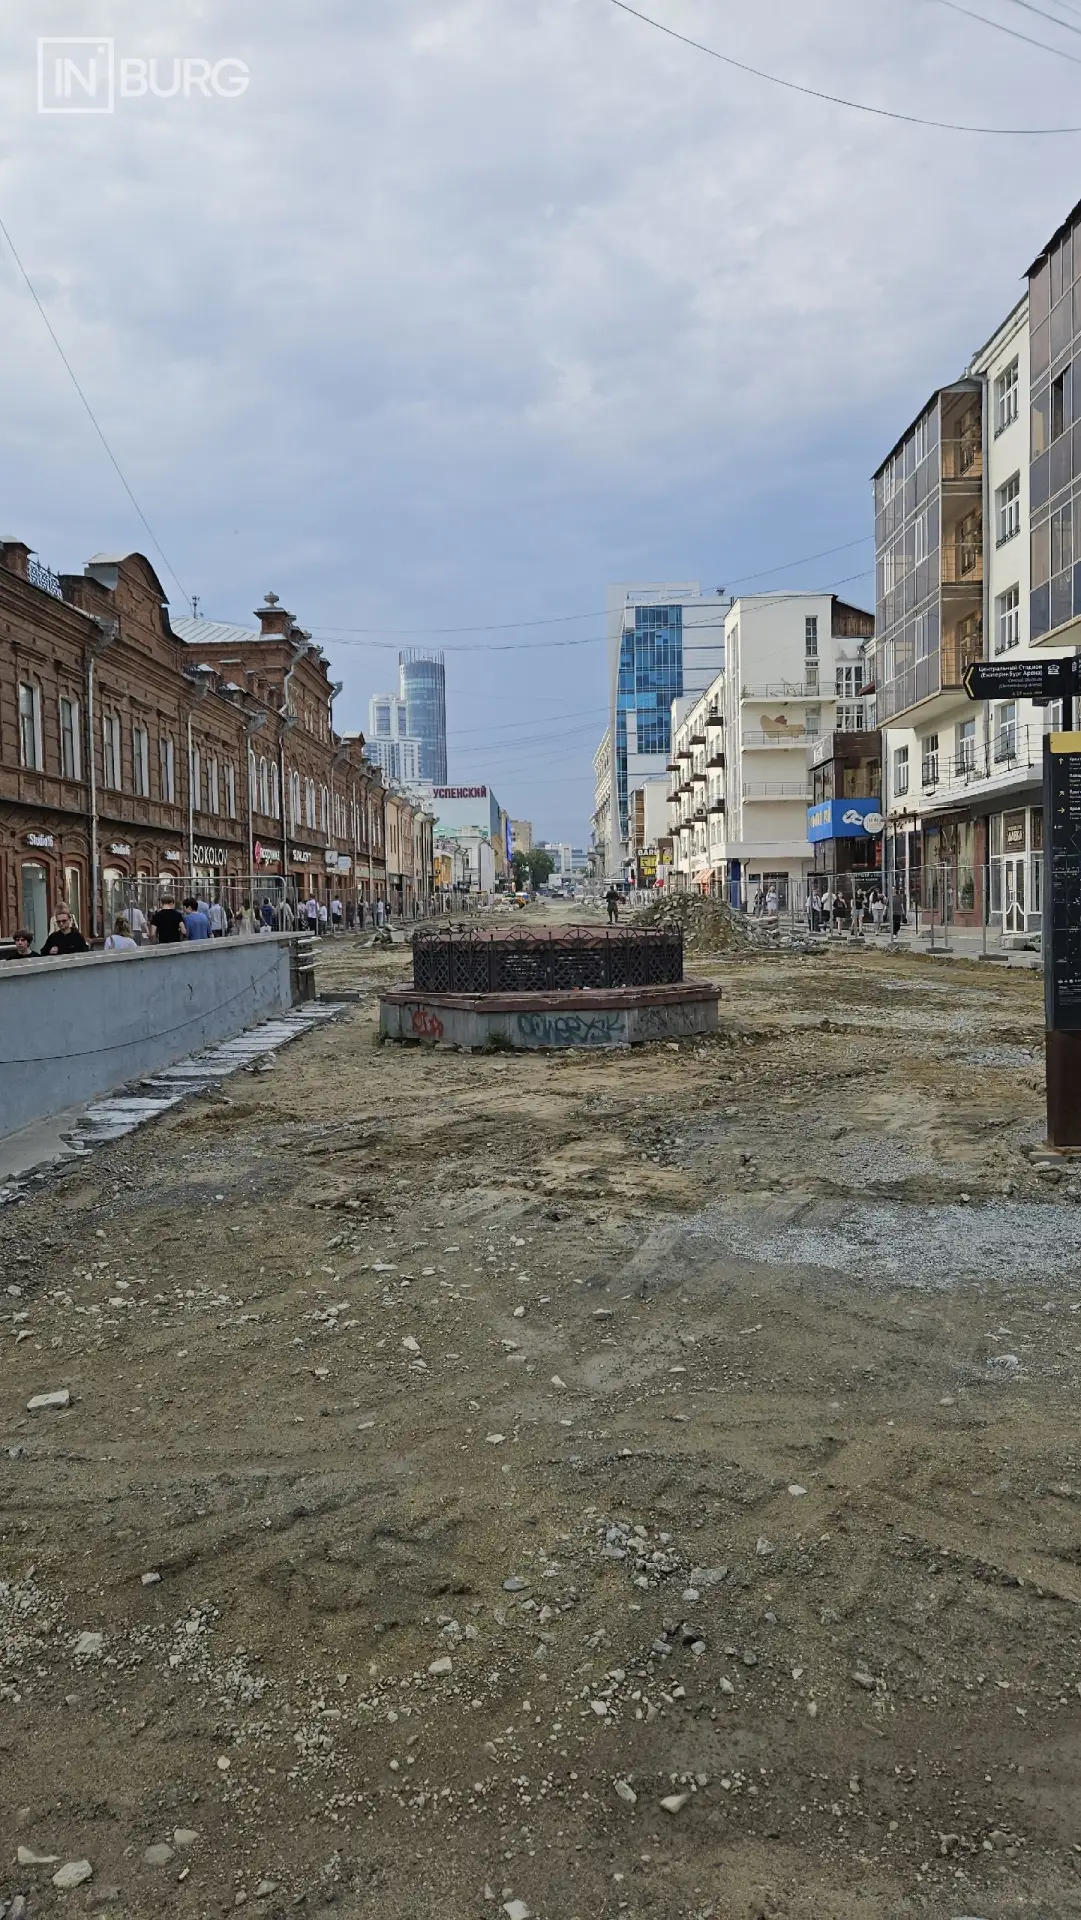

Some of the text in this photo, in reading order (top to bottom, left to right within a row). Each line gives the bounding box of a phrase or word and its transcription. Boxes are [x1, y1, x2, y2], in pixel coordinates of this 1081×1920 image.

[978, 665, 1018, 673] Центральный
[433, 785, 487, 799] УСПЕНСКИЙ
[193, 844, 228, 866] SOKOLOV
